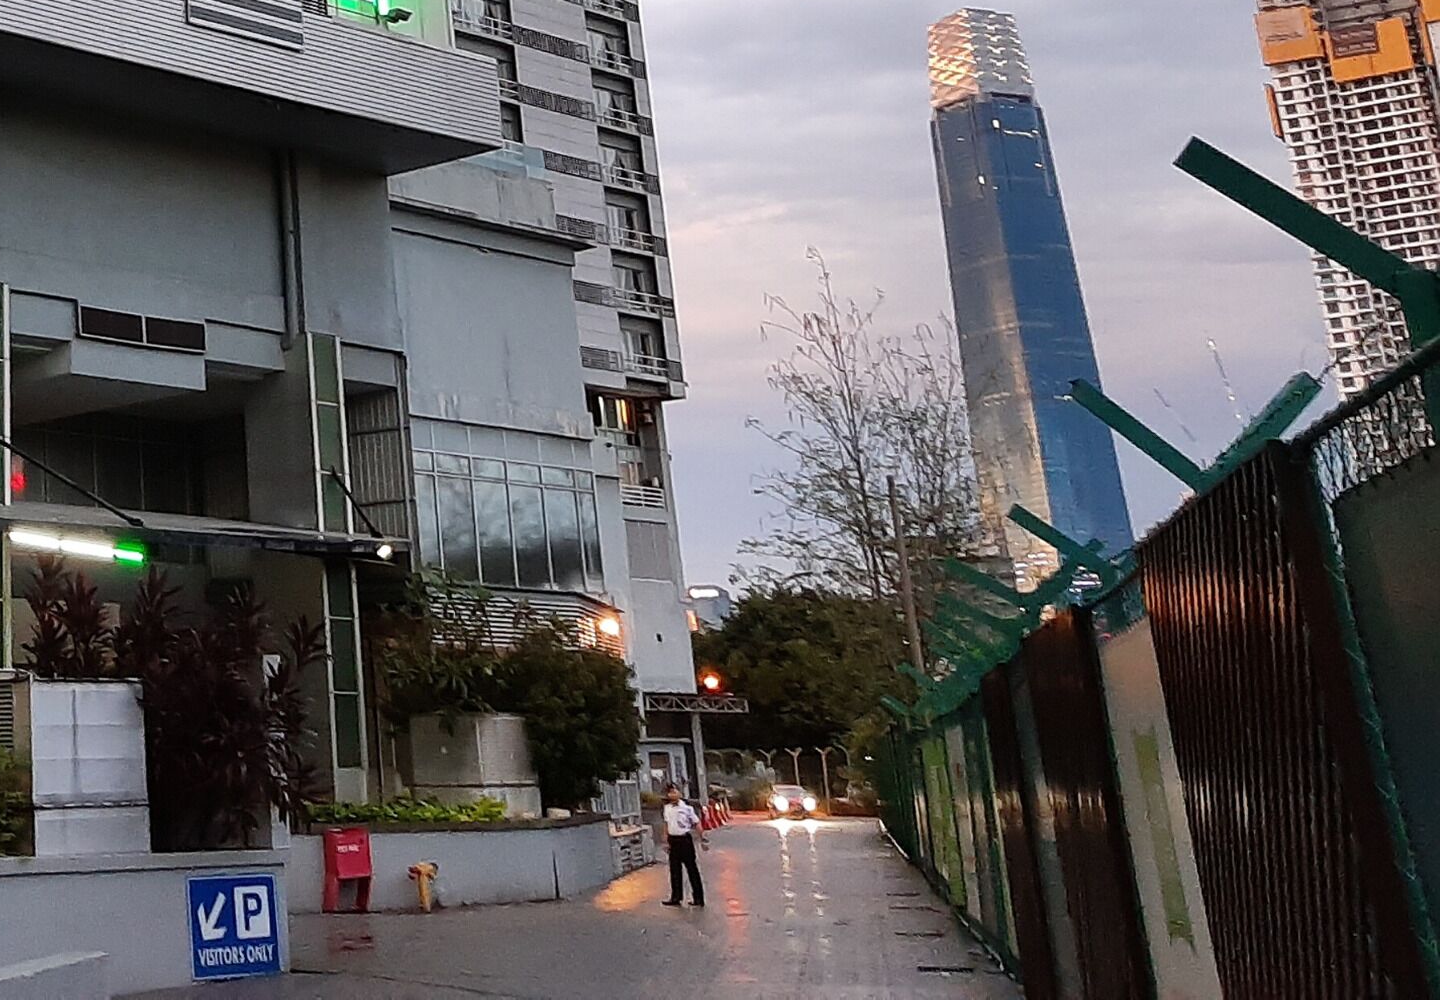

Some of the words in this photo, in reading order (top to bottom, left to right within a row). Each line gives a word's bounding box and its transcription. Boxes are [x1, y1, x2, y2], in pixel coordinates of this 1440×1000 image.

[243, 893, 262, 931] P
[198, 946, 245, 967] VISITORS
[246, 943, 275, 963] ONLY
